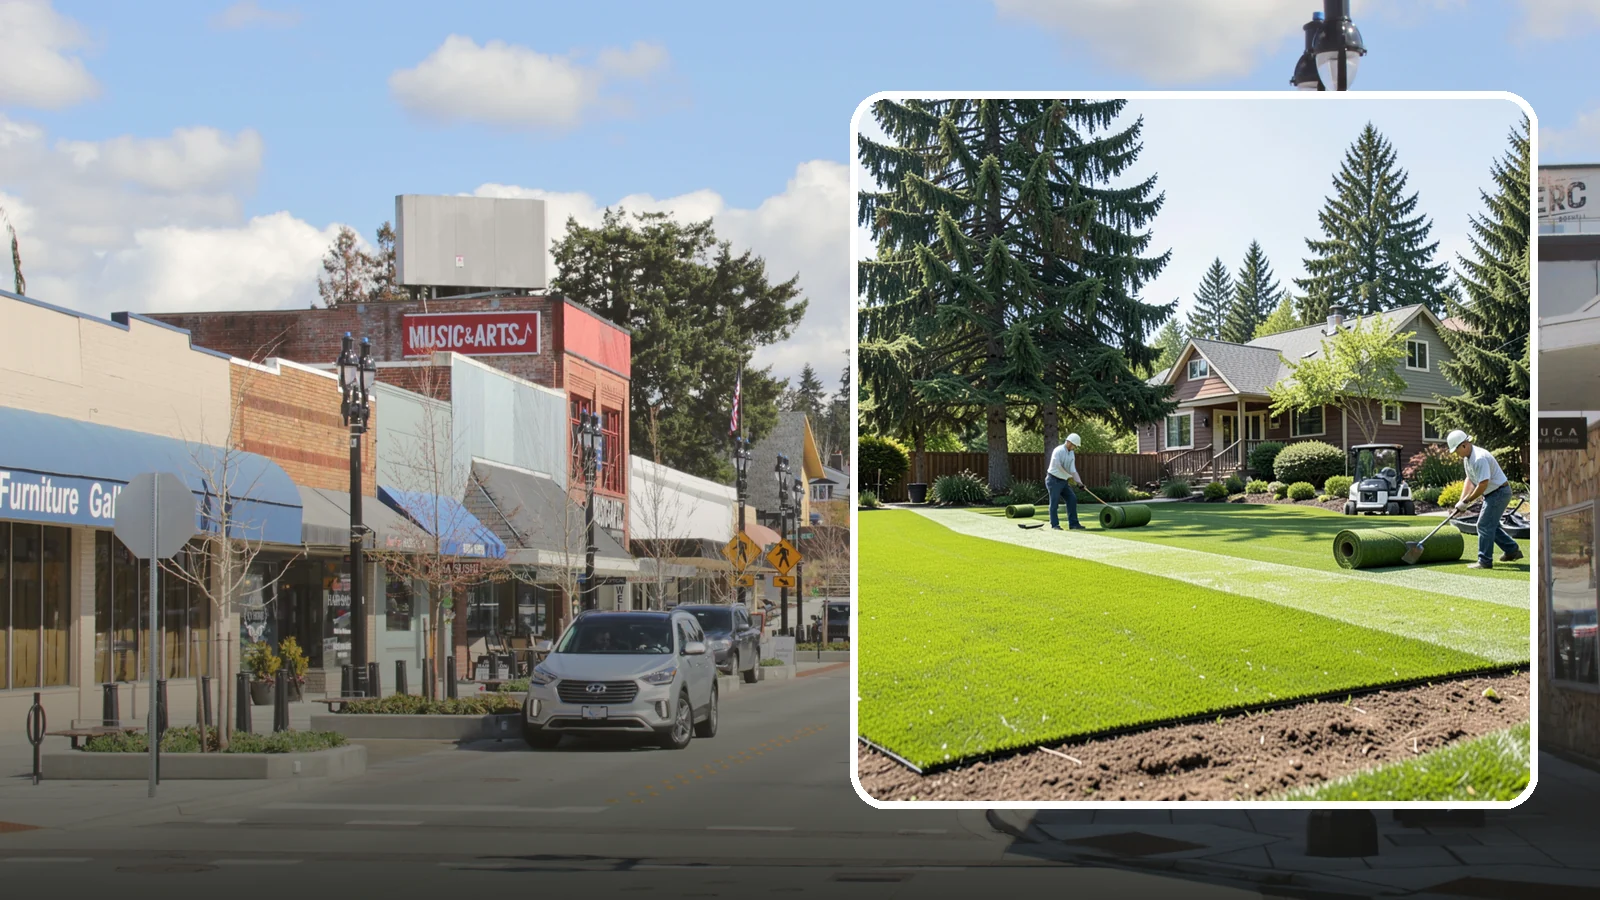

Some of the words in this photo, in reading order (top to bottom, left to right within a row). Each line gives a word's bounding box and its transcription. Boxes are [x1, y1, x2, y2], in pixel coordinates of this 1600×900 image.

[408, 322, 520, 349] MUSIC&ARTS
[0, 471, 79, 515] Furniture
[89, 482, 122, 519] Gal
